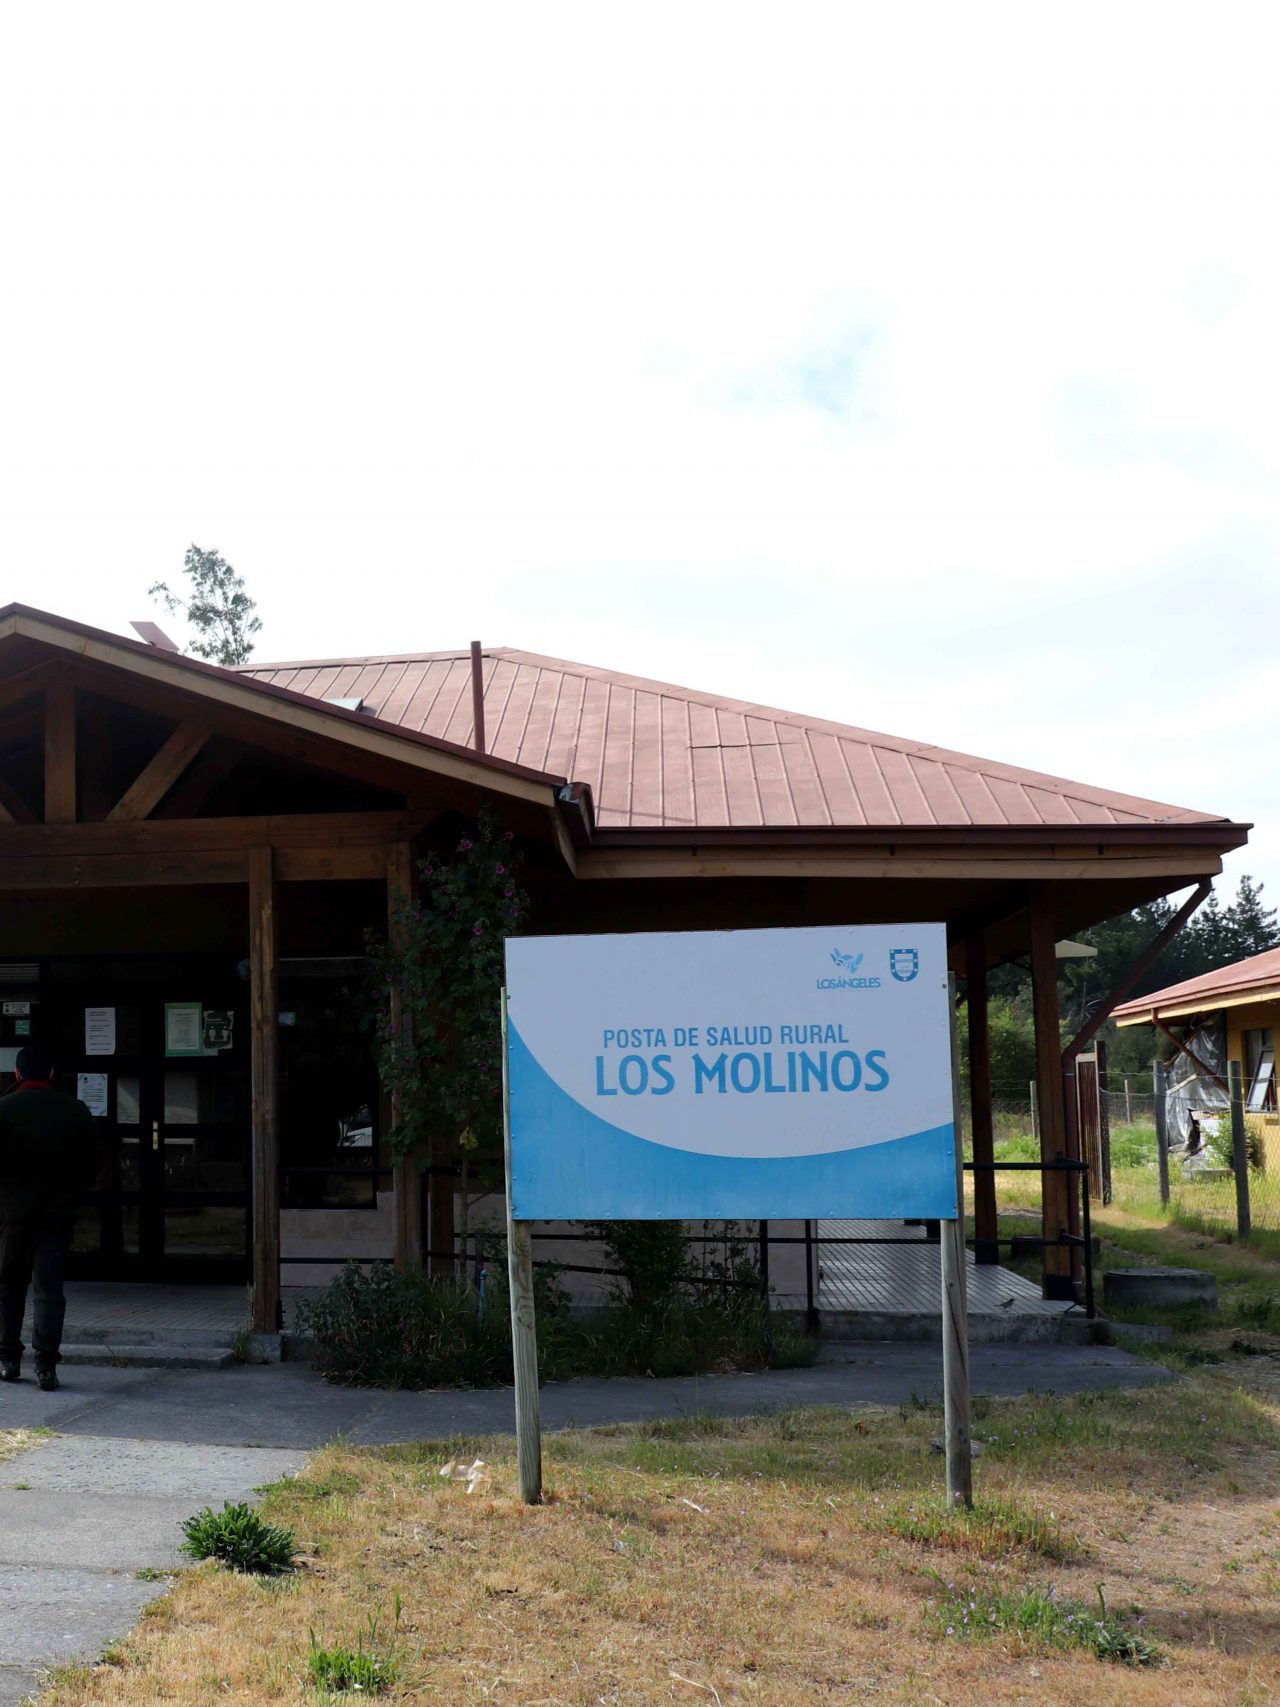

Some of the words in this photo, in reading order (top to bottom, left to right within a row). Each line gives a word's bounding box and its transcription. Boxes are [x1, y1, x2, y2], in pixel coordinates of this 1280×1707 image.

[603, 1029, 667, 1049] POSTA
[674, 1027, 699, 1047] DE
[707, 1025, 772, 1046] SALUD
[780, 1024, 849, 1044] RURAL
[596, 1054, 675, 1096] LOS
[692, 1050, 890, 1094] MOLINOS
